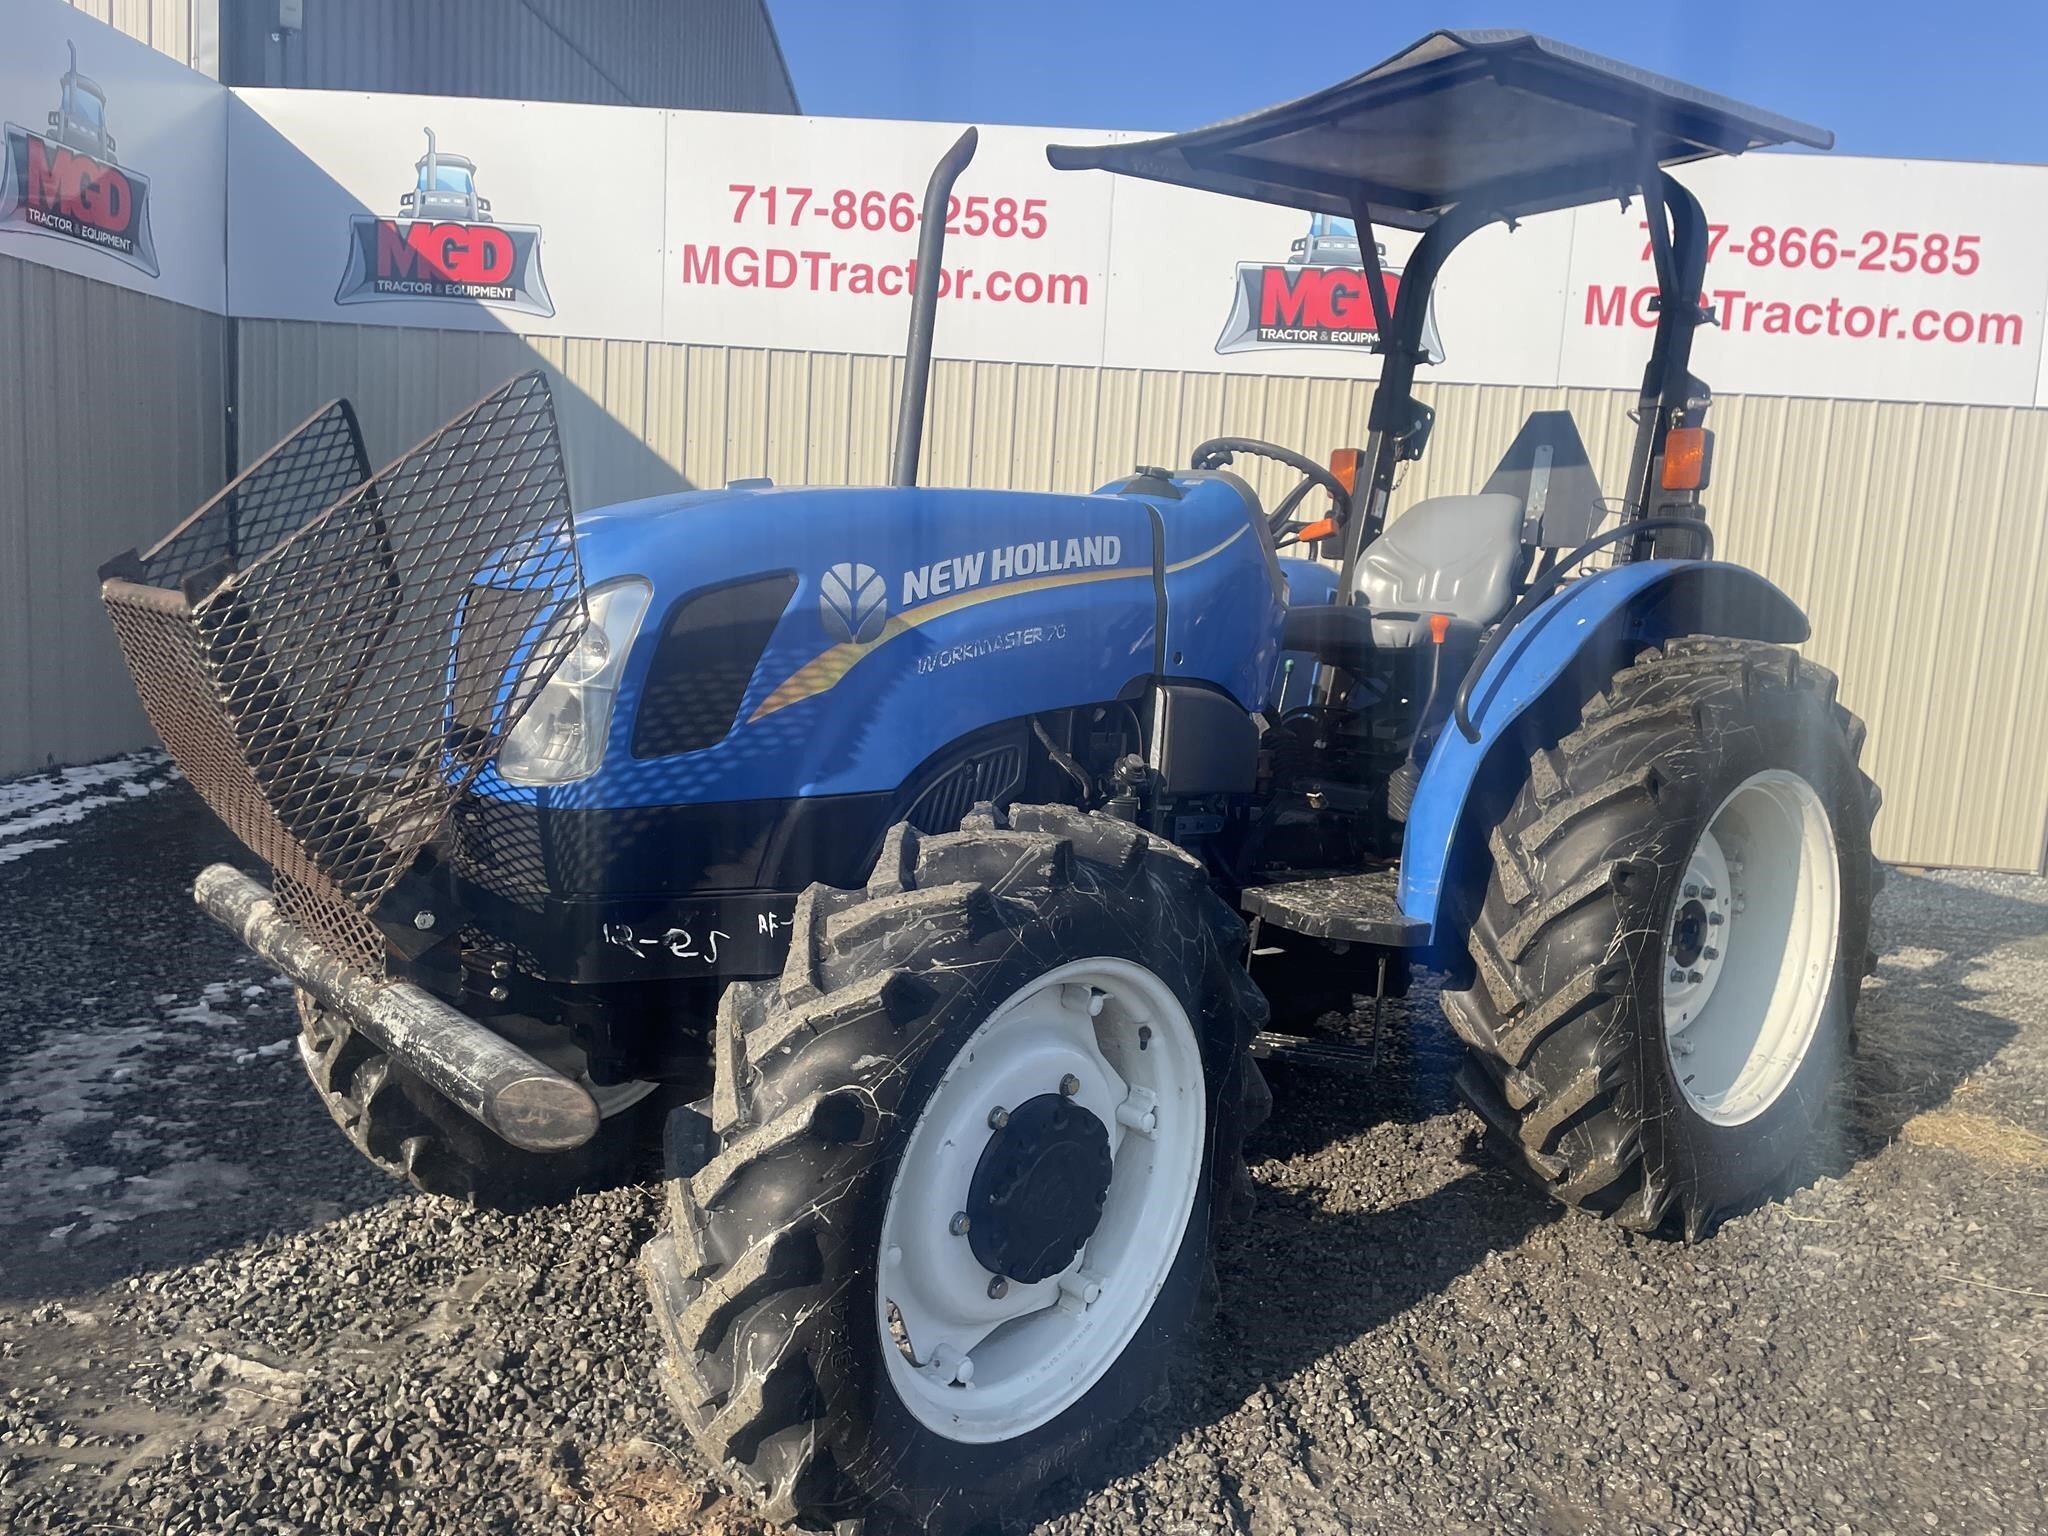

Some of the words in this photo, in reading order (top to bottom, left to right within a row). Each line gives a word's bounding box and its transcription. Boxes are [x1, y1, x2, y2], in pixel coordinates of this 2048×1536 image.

[27, 134, 132, 232] MGD
[28, 208, 73, 233] TRACTOR
[81, 225, 132, 250] EQUIPMENT
[377, 220, 515, 284] MGD
[377, 280, 432, 294] TRACTOR
[445, 284, 513, 299] EQUIPMENT
[1584, 285, 2024, 347] MGTractor.com
[1260, 328, 1317, 341] TRACTOR
[1319, 331, 1329, 341] &
[1331, 331, 1381, 344] EQUIPM
[902, 551, 985, 606] NEW
[991, 535, 1122, 581] HOLLAND
[917, 627, 1042, 674] WORKMASTER
